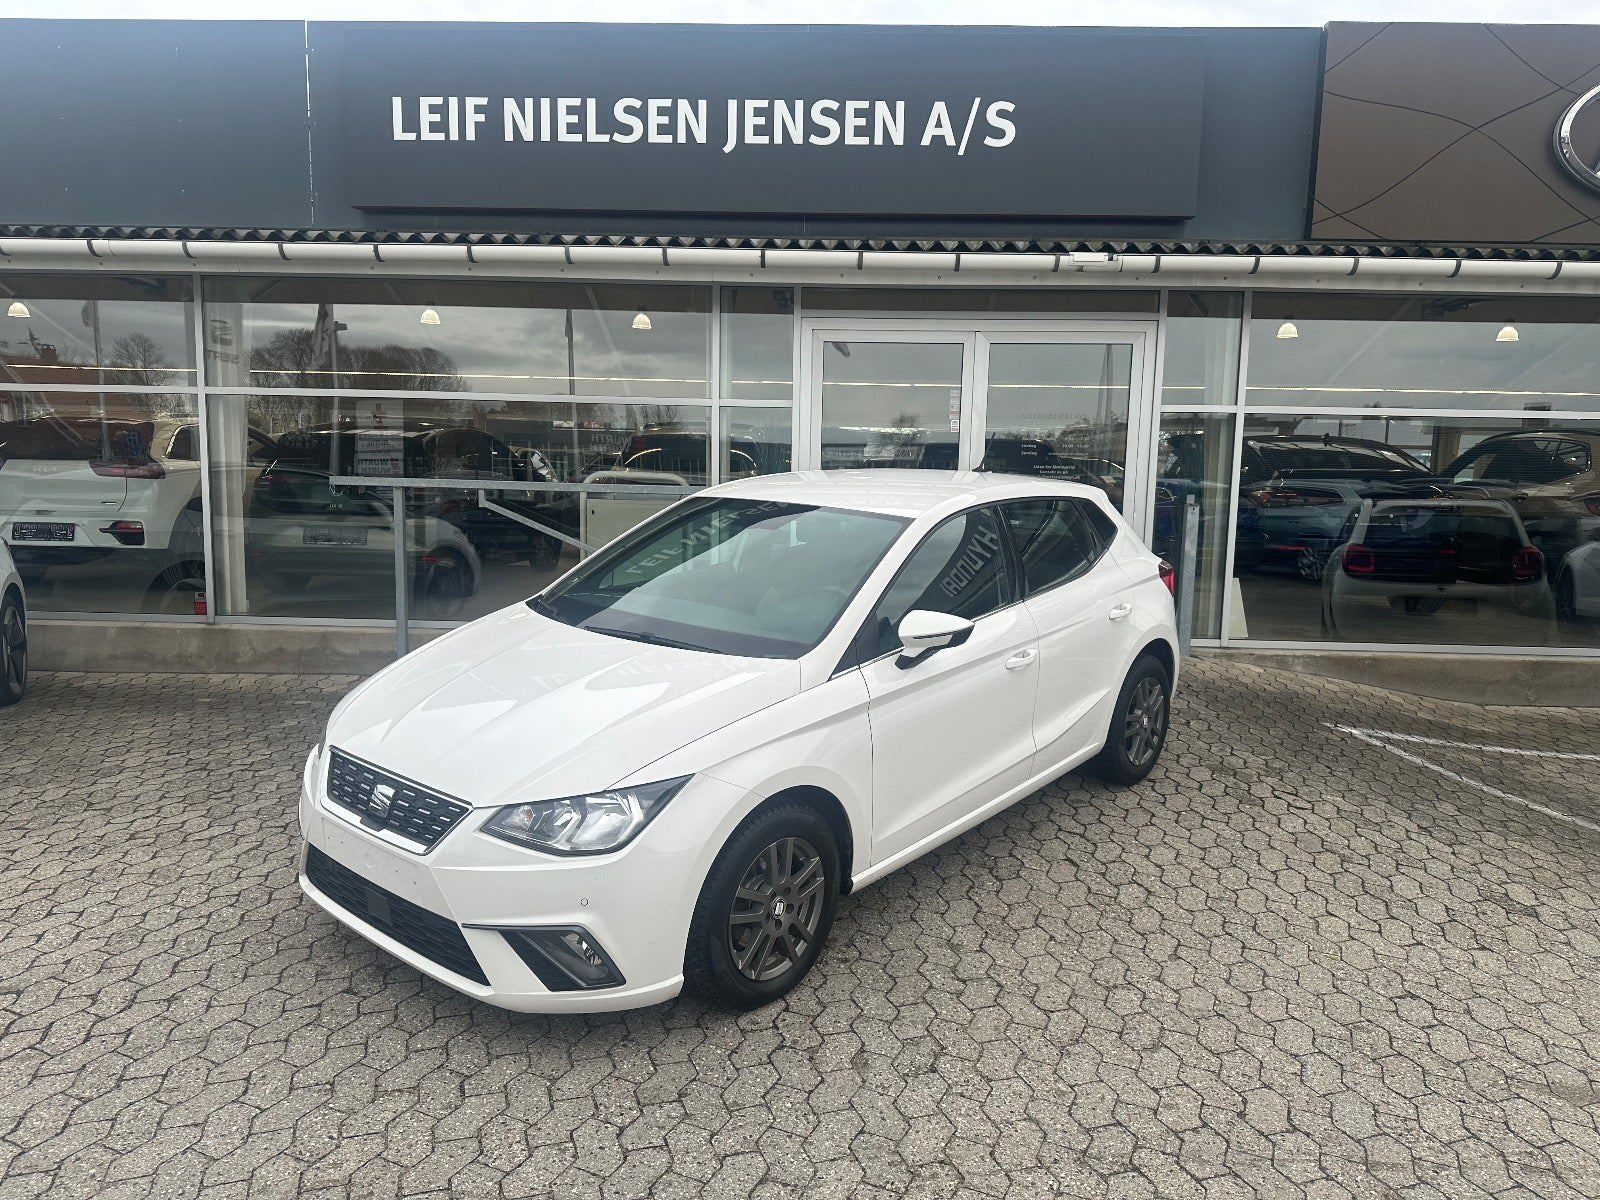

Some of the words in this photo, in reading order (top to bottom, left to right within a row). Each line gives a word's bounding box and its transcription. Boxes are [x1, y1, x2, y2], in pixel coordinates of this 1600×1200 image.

[392, 96, 488, 141] LEIF
[503, 97, 707, 144] NIELSEN
[722, 99, 905, 154] JENSEN
[920, 97, 1016, 156] A/S
